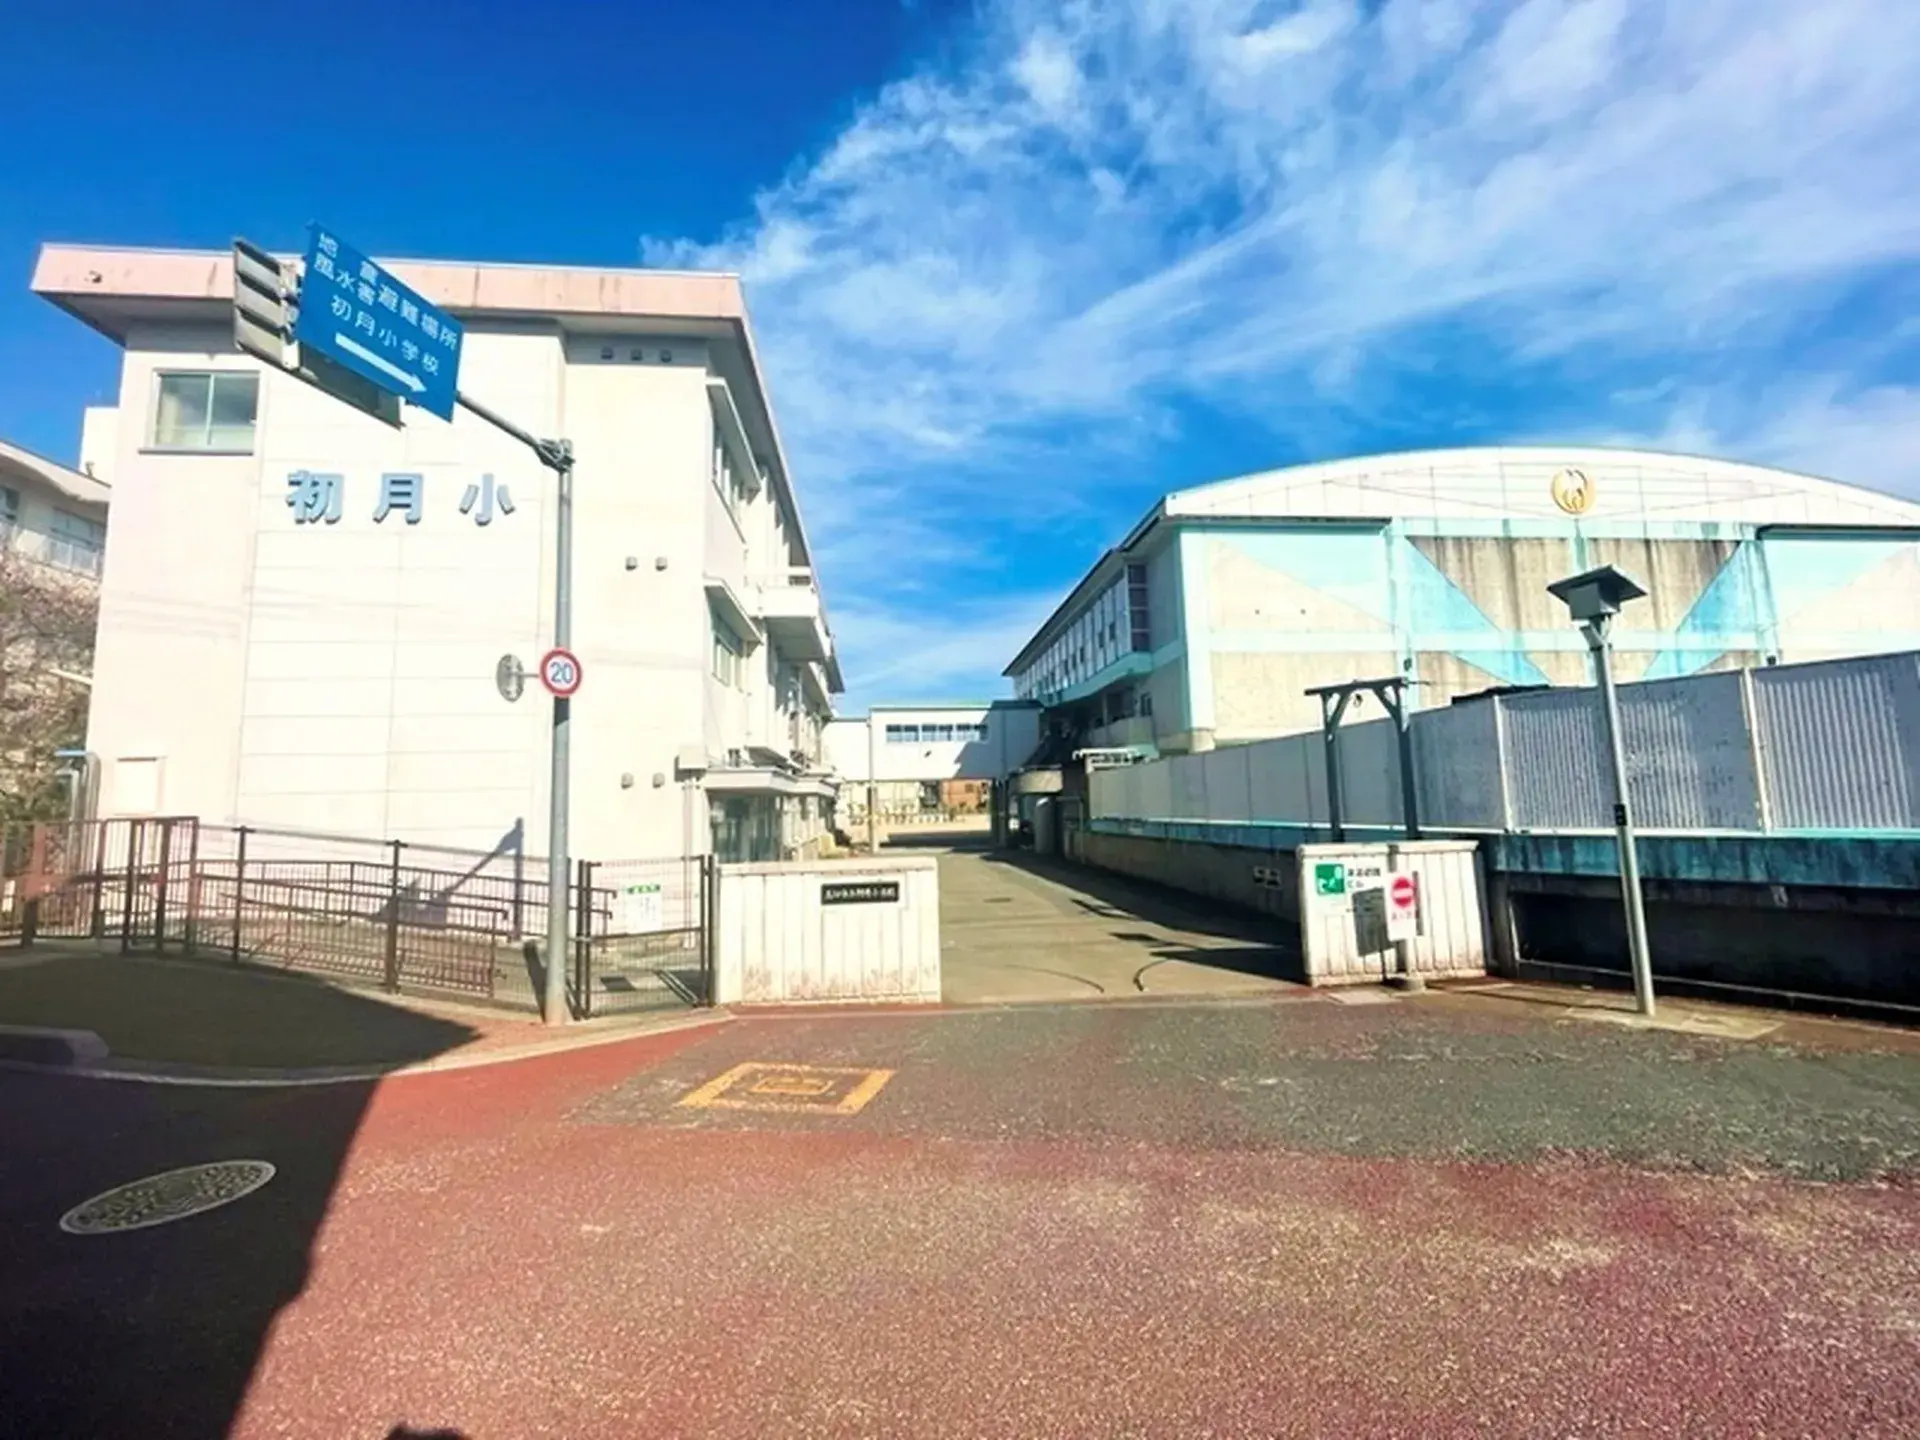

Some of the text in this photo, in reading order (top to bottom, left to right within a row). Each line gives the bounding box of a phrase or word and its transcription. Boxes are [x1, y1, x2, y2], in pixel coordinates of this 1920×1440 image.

[330, 294, 439, 376] 初月小学校
[286, 470, 516, 526] 初月小
[550, 661, 574, 684] 20
